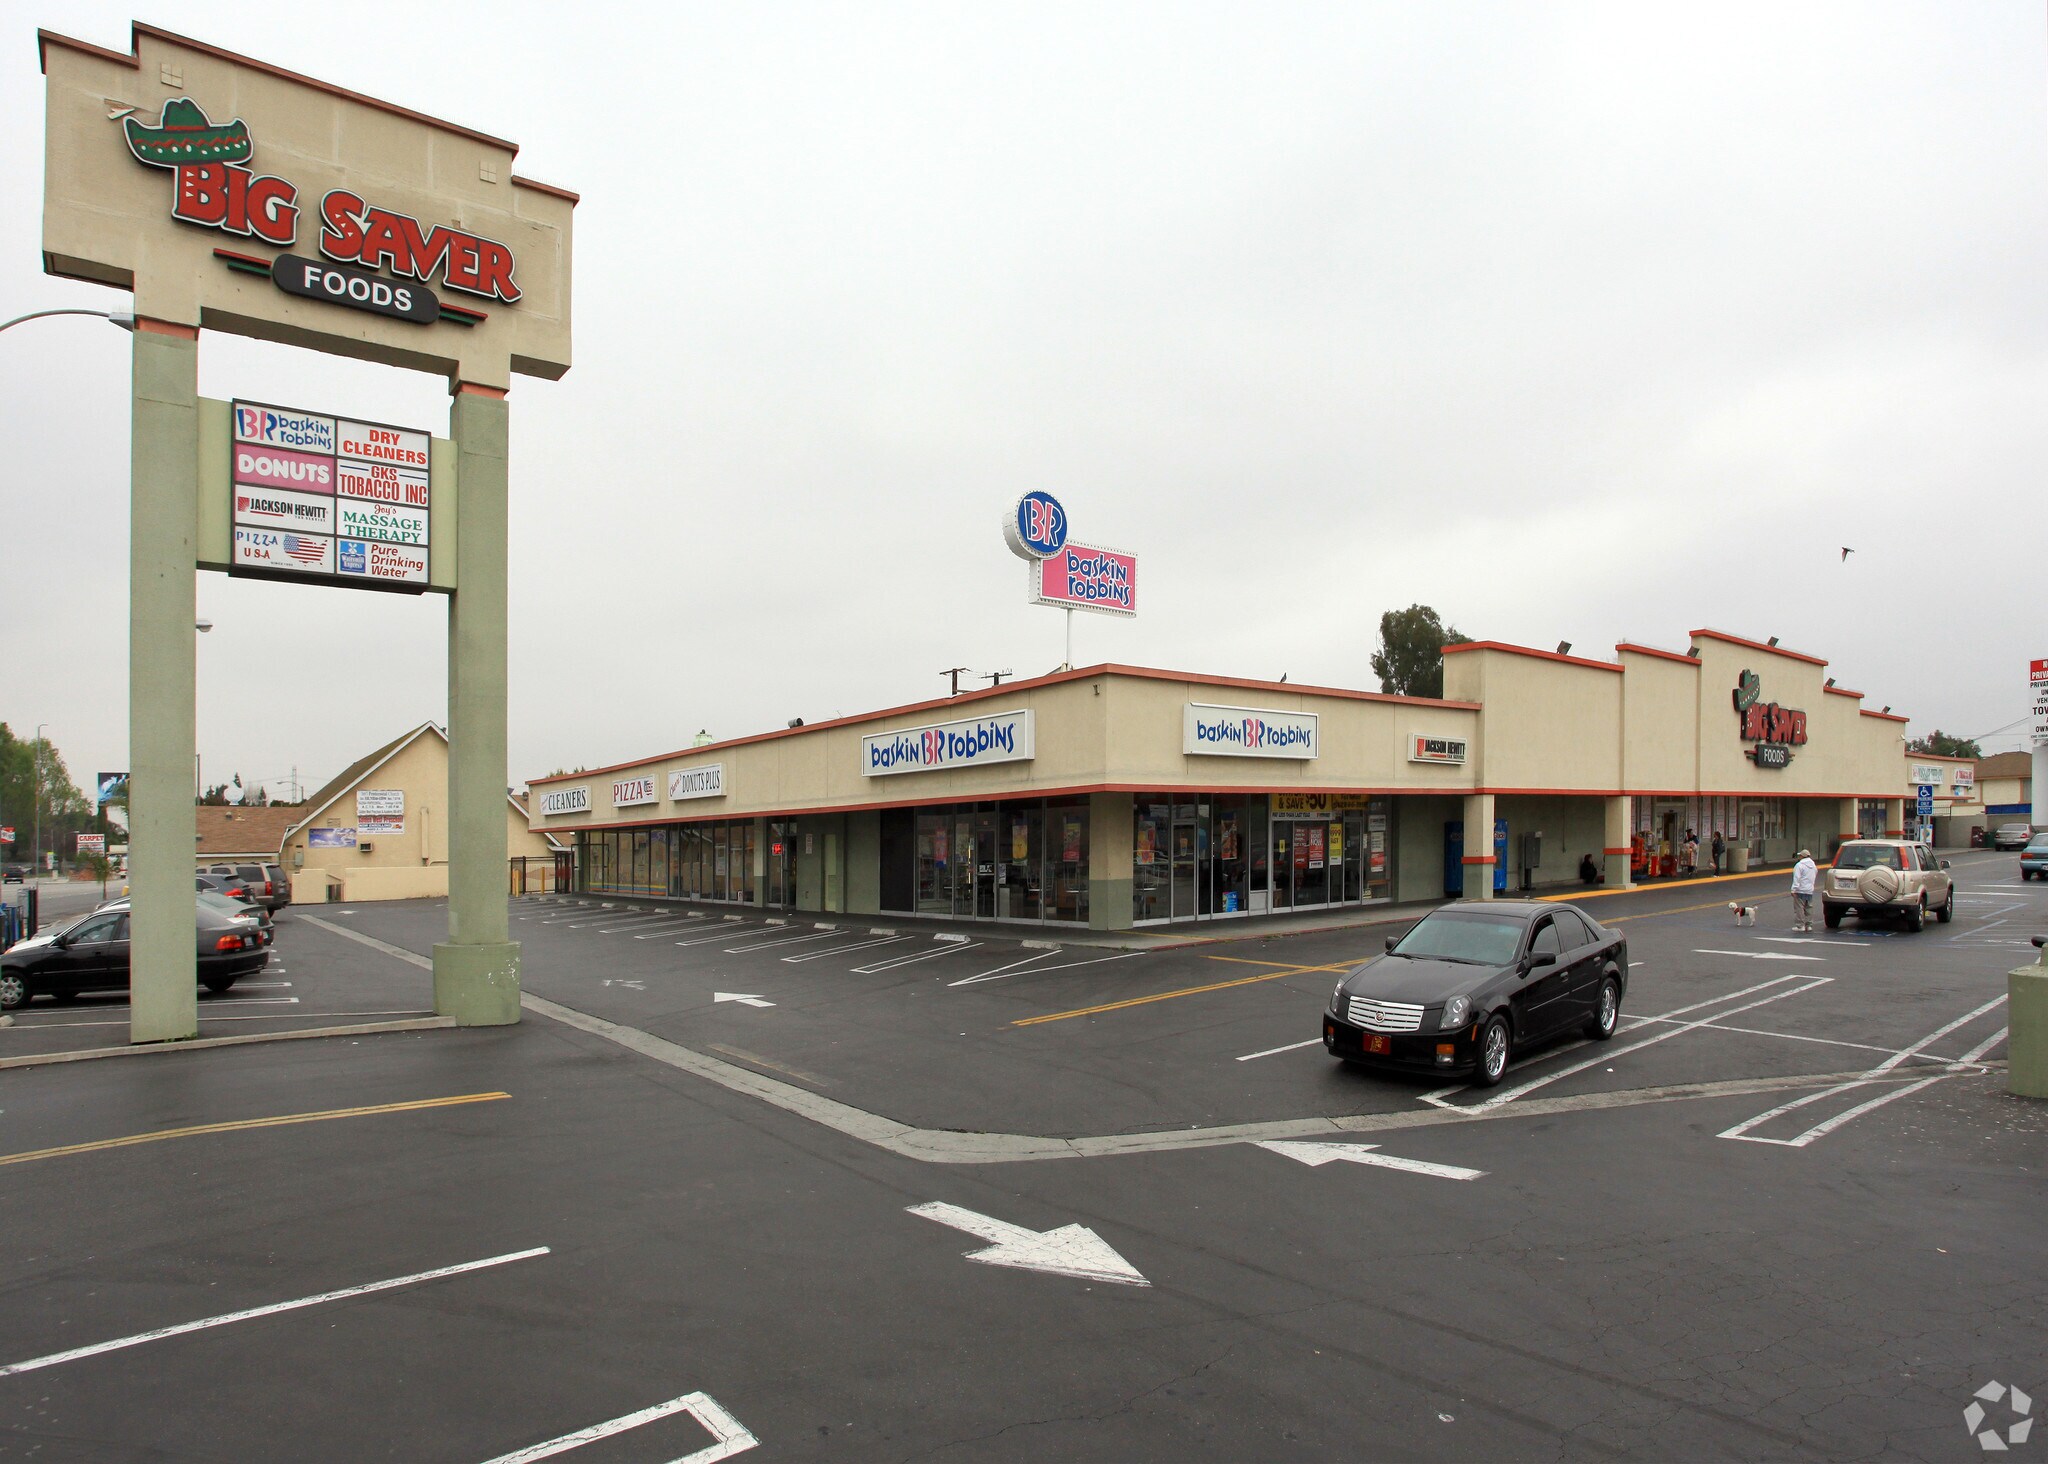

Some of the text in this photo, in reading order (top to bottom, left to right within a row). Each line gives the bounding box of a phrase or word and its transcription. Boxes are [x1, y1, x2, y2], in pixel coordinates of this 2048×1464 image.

[173, 160, 523, 304] BIG SAVER
[303, 265, 414, 313] FOODS
[236, 407, 279, 441] BR
[369, 429, 401, 446] DRY
[342, 439, 427, 465] CLEANERS
[238, 453, 331, 485] DONUTS
[371, 465, 397, 481] GKS
[339, 473, 428, 505] TOBACCO INC
[250, 497, 327, 519] JACKSON HEWITT
[374, 504, 397, 516] Joy's
[343, 510, 423, 531] MASSAGE
[1024, 498, 1062, 547] BR
[236, 531, 279, 547] PIZZA
[344, 524, 421, 544] THERAPY
[370, 543, 399, 557] Pure
[370, 554, 424, 572] Drinking
[371, 565, 408, 578] Water
[1242, 717, 1266, 749] BR
[1745, 701, 1808, 746] BIG SAVER
[920, 729, 946, 766] BR
[1763, 748, 1785, 764] FOODS
[613, 780, 644, 803] PIZZA
[682, 772, 705, 794] DONUTS
[705, 769, 721, 791] PLUS
[548, 789, 587, 811] CLEANERS
[1278, 797, 1284, 810] &
[1285, 797, 1304, 810] SAVE
[1872, 879, 1893, 895] HONDA
